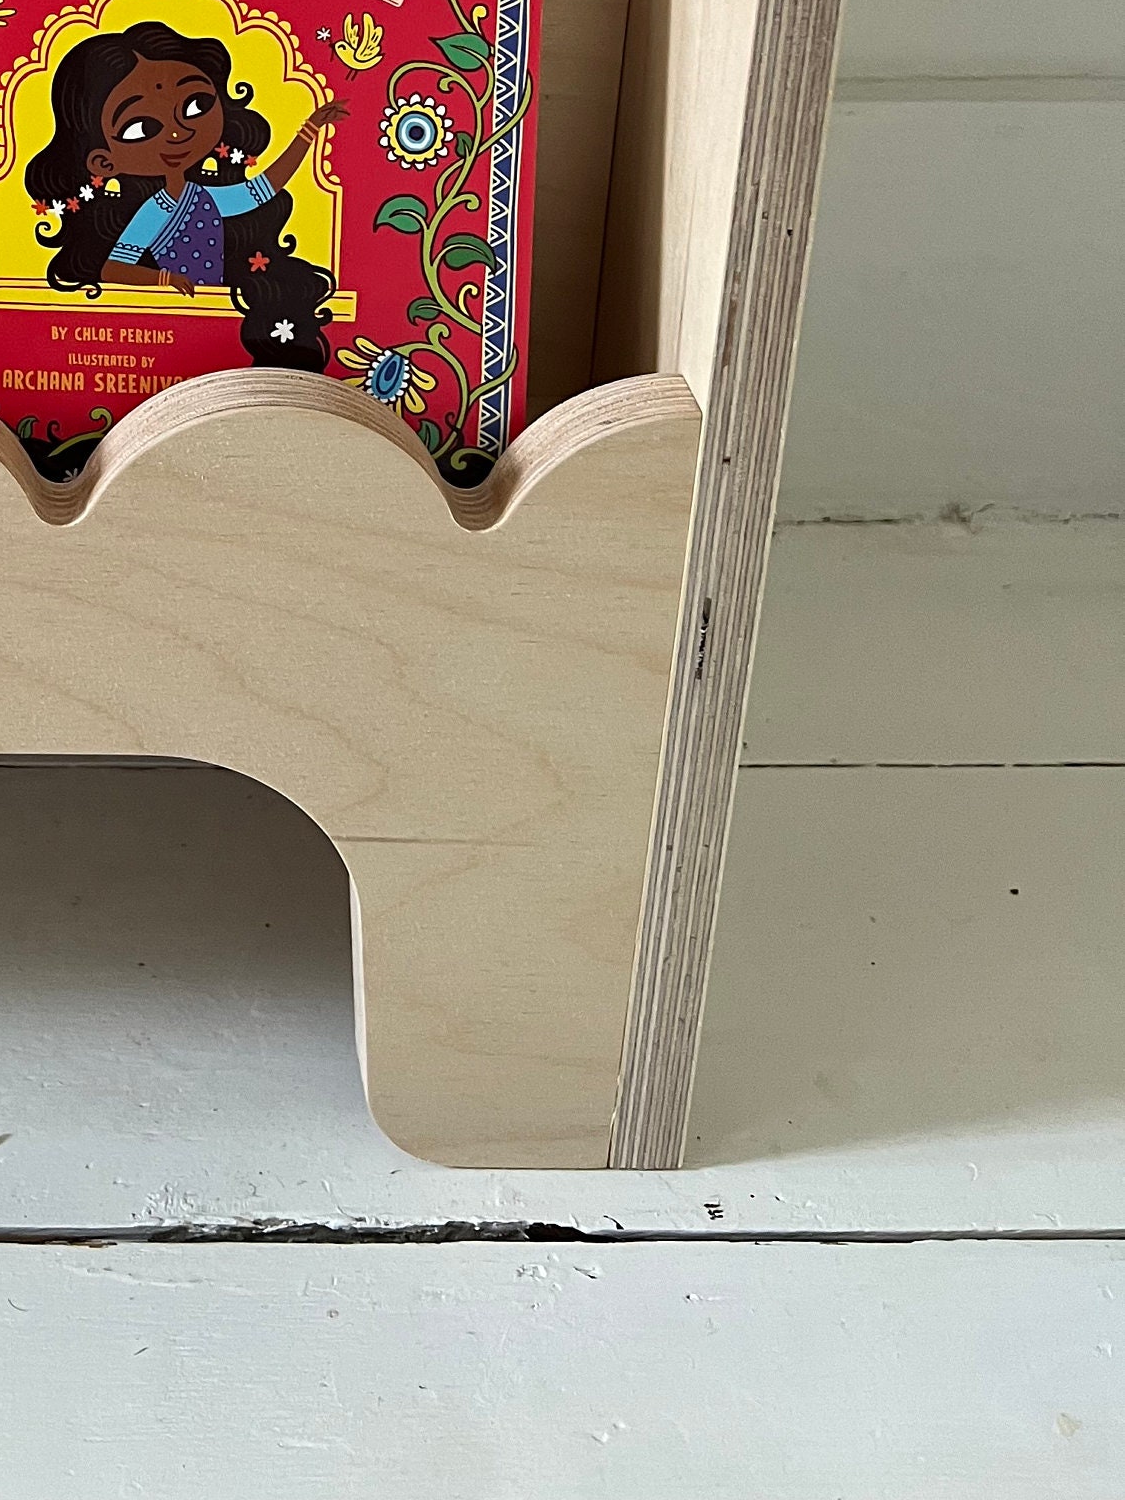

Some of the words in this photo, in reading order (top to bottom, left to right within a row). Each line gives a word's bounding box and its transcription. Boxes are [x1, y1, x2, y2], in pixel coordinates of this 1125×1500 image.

[51, 325, 68, 341] BY
[74, 327, 114, 343] CHLOE
[119, 329, 174, 344] PERKINS
[68, 353, 137, 368] ILLUSTRATED
[141, 356, 155, 368] BY
[2, 369, 84, 391] ARCHANA
[93, 372, 194, 394] SREENIV
